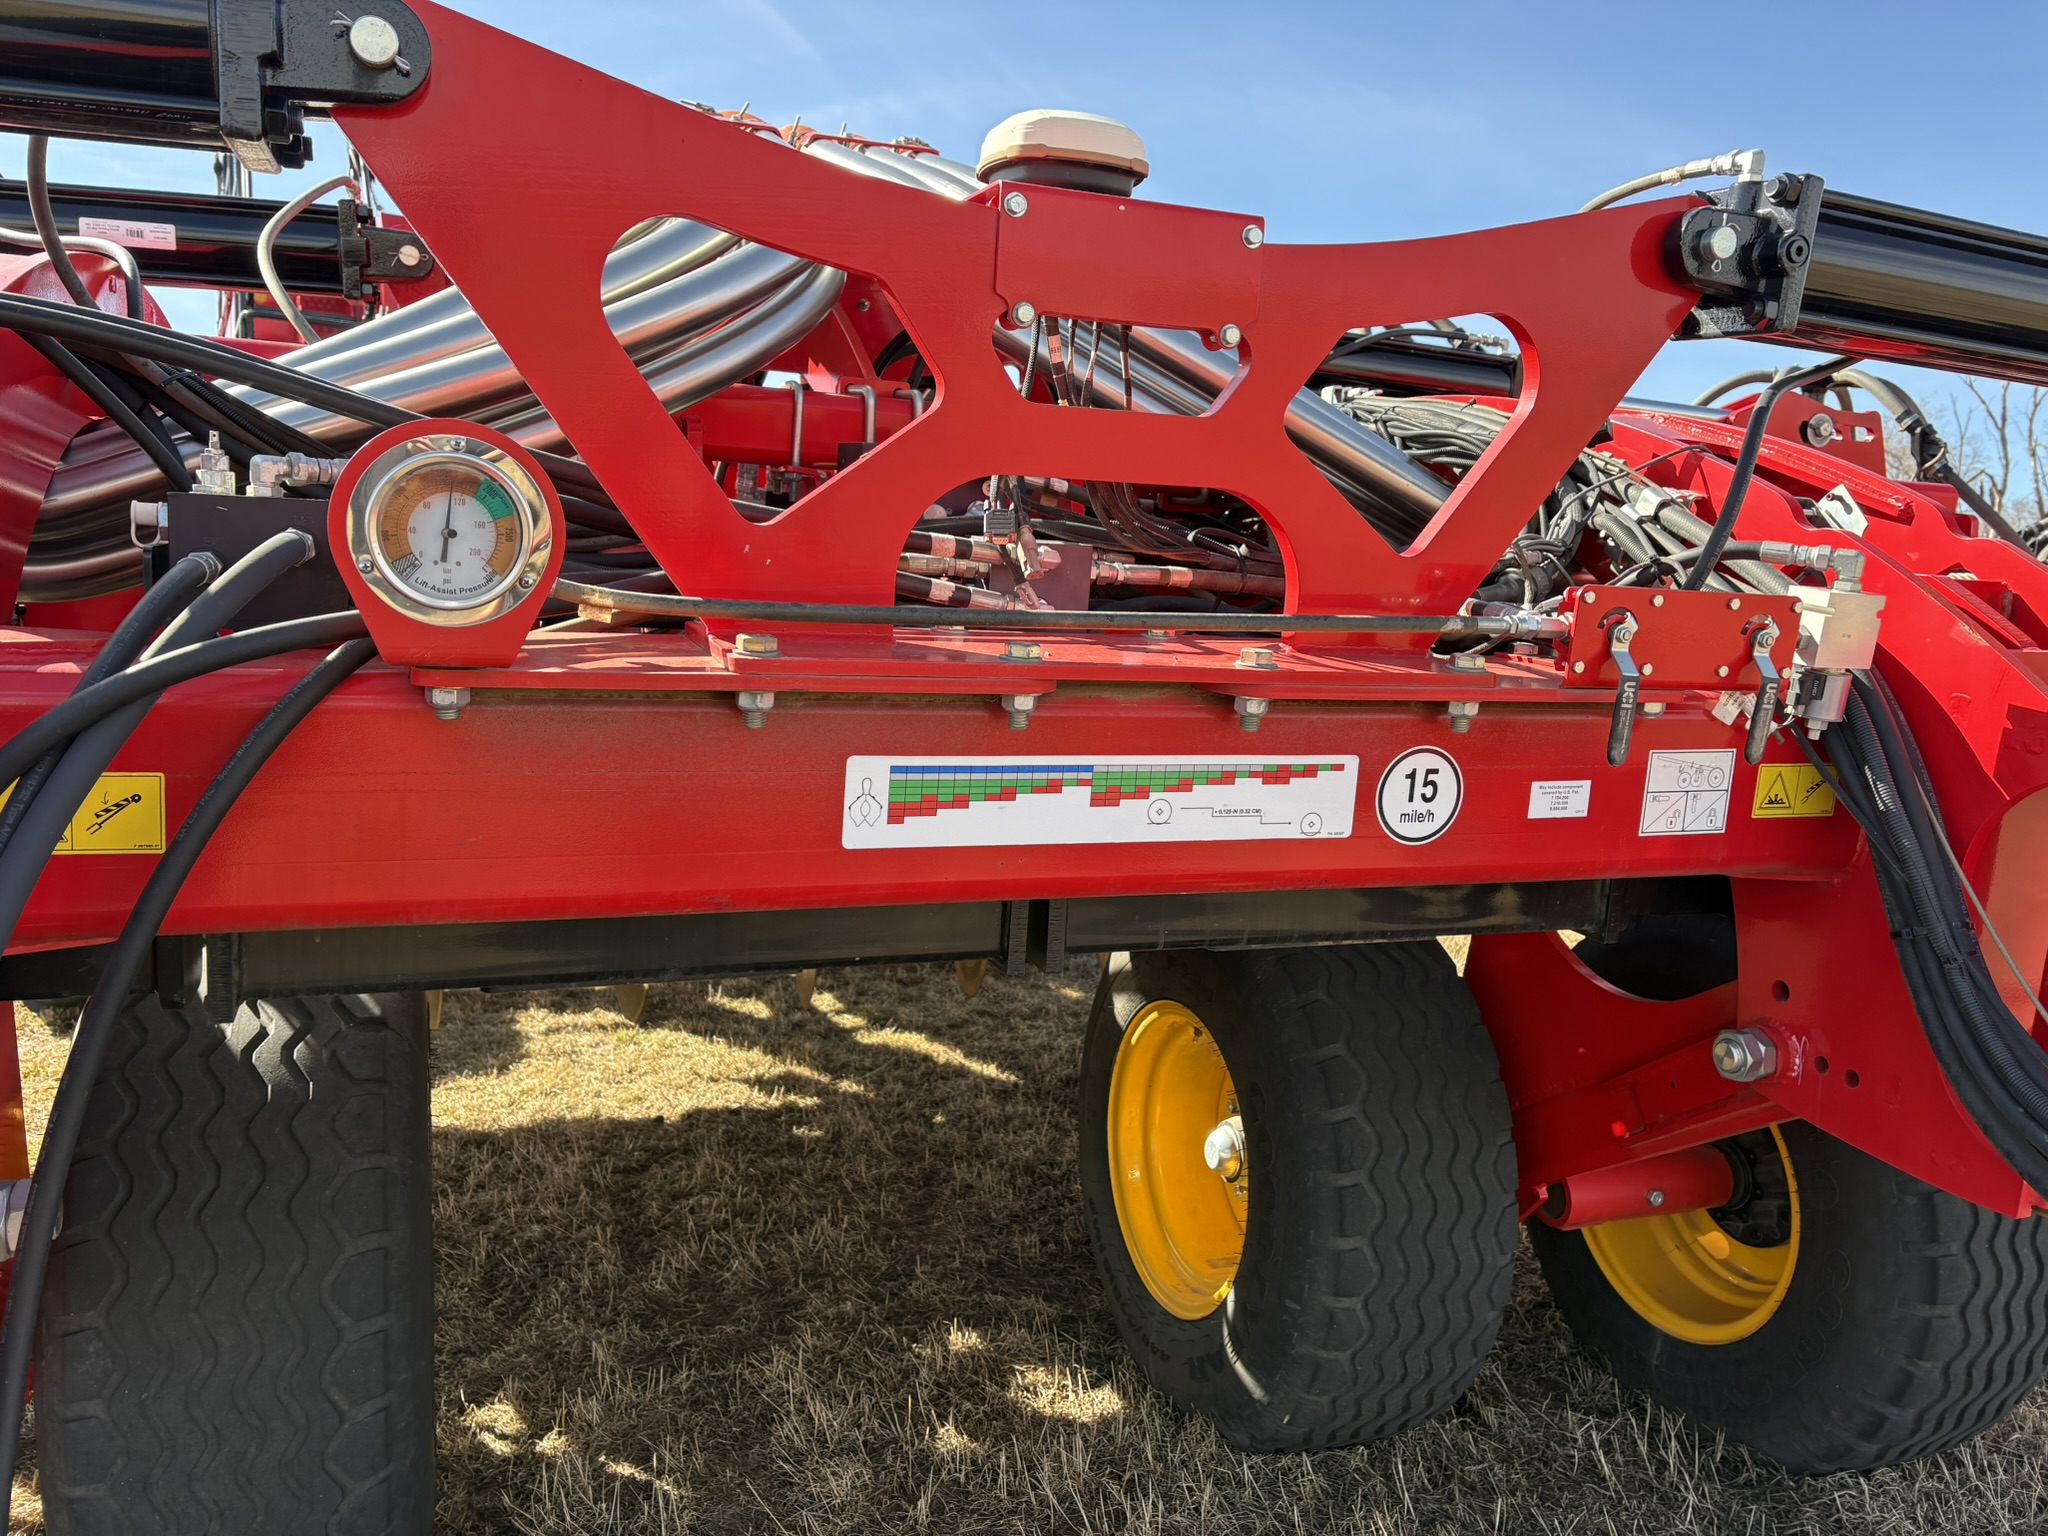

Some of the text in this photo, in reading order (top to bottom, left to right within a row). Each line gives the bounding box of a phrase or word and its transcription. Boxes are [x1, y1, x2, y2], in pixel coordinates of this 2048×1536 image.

[423, 501, 431, 510] 80
[454, 498, 466, 506] 120
[474, 521, 486, 529] 160
[408, 526, 416, 534] 40
[470, 548, 481, 556] 200
[415, 576, 494, 594] Lift-Assist Pressure
[1405, 768, 1439, 803] 15
[1399, 810, 1435, 824] mile/h
